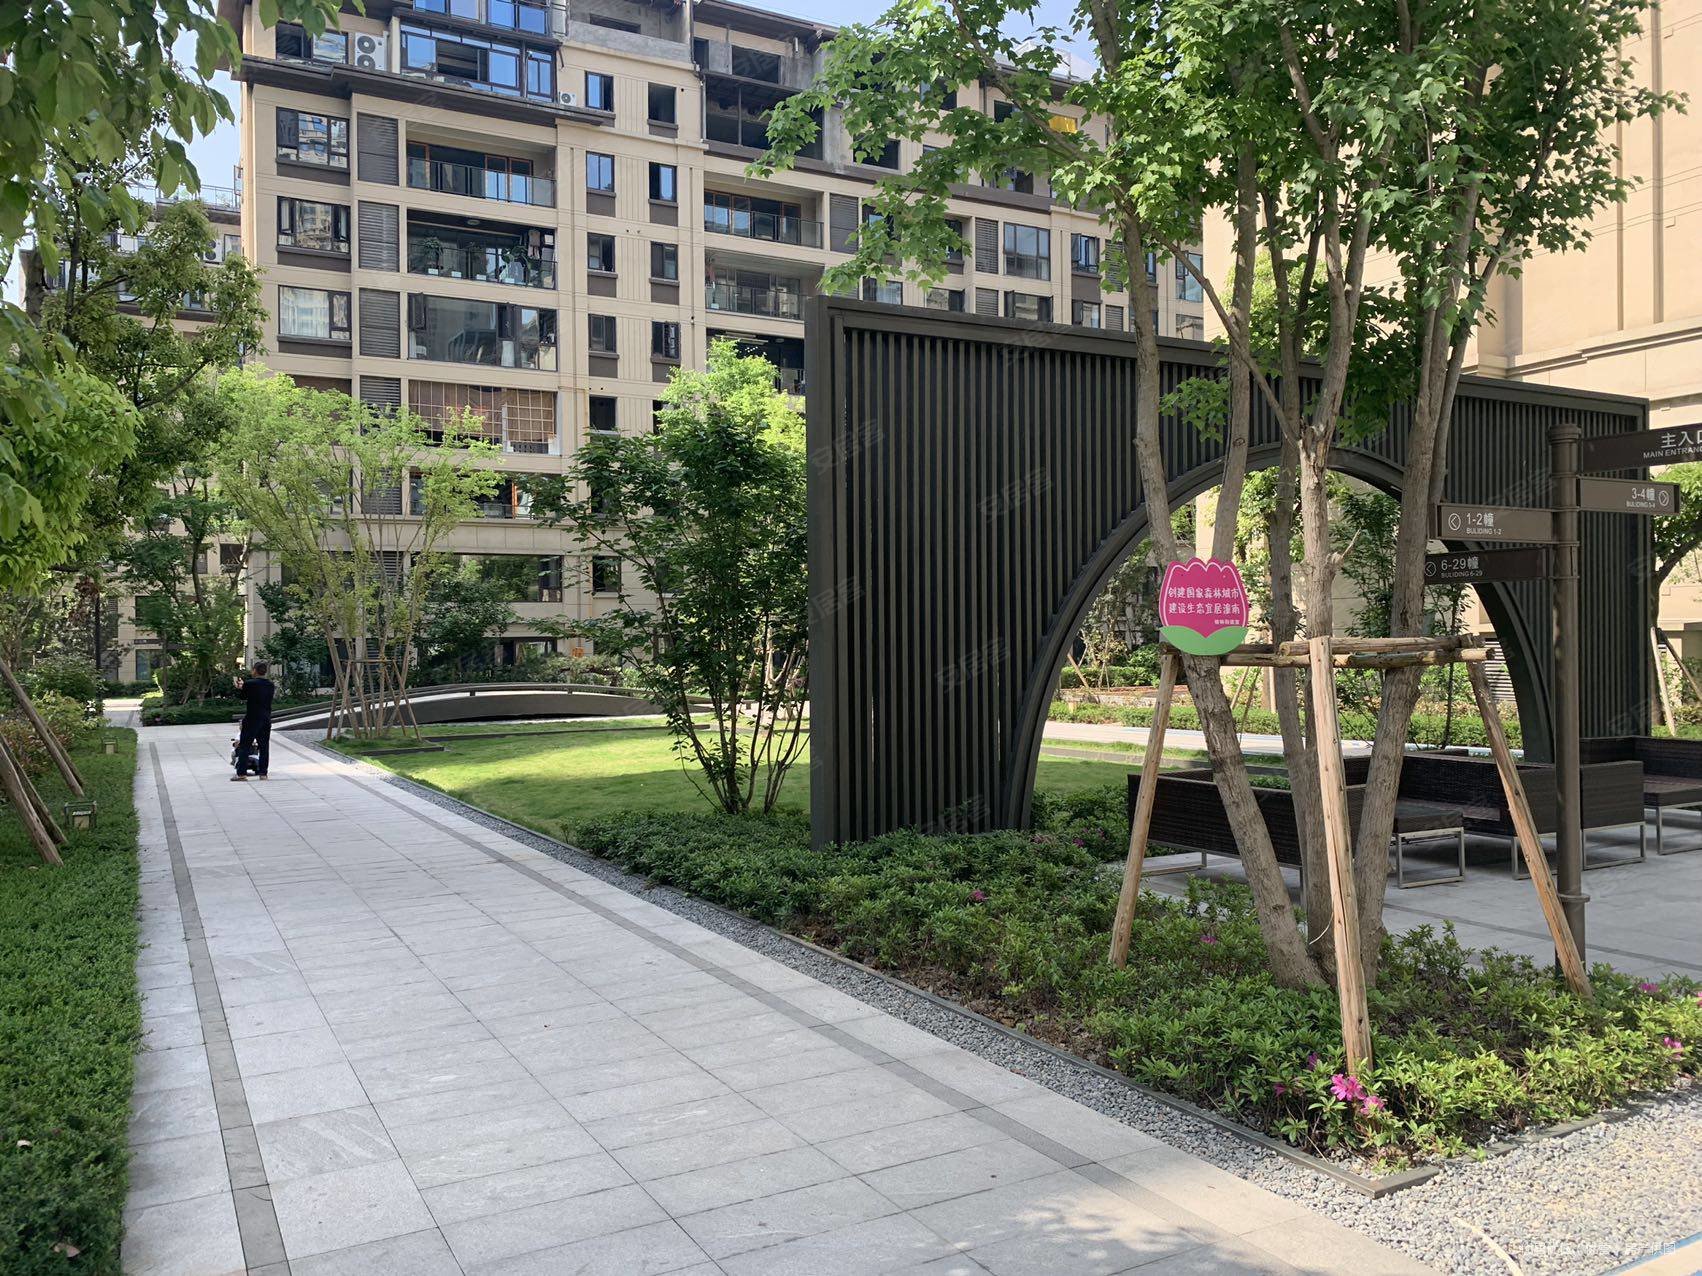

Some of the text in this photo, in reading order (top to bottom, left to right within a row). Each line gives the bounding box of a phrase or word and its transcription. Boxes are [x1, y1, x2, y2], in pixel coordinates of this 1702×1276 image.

[1661, 429, 1702, 449] 主入口
[1643, 449, 1664, 459] MAIN
[1466, 512, 1494, 527] 1-2幢
[1441, 556, 1479, 571] 6-29幢
[1168, 586, 1240, 599] 创建国家森林城市
